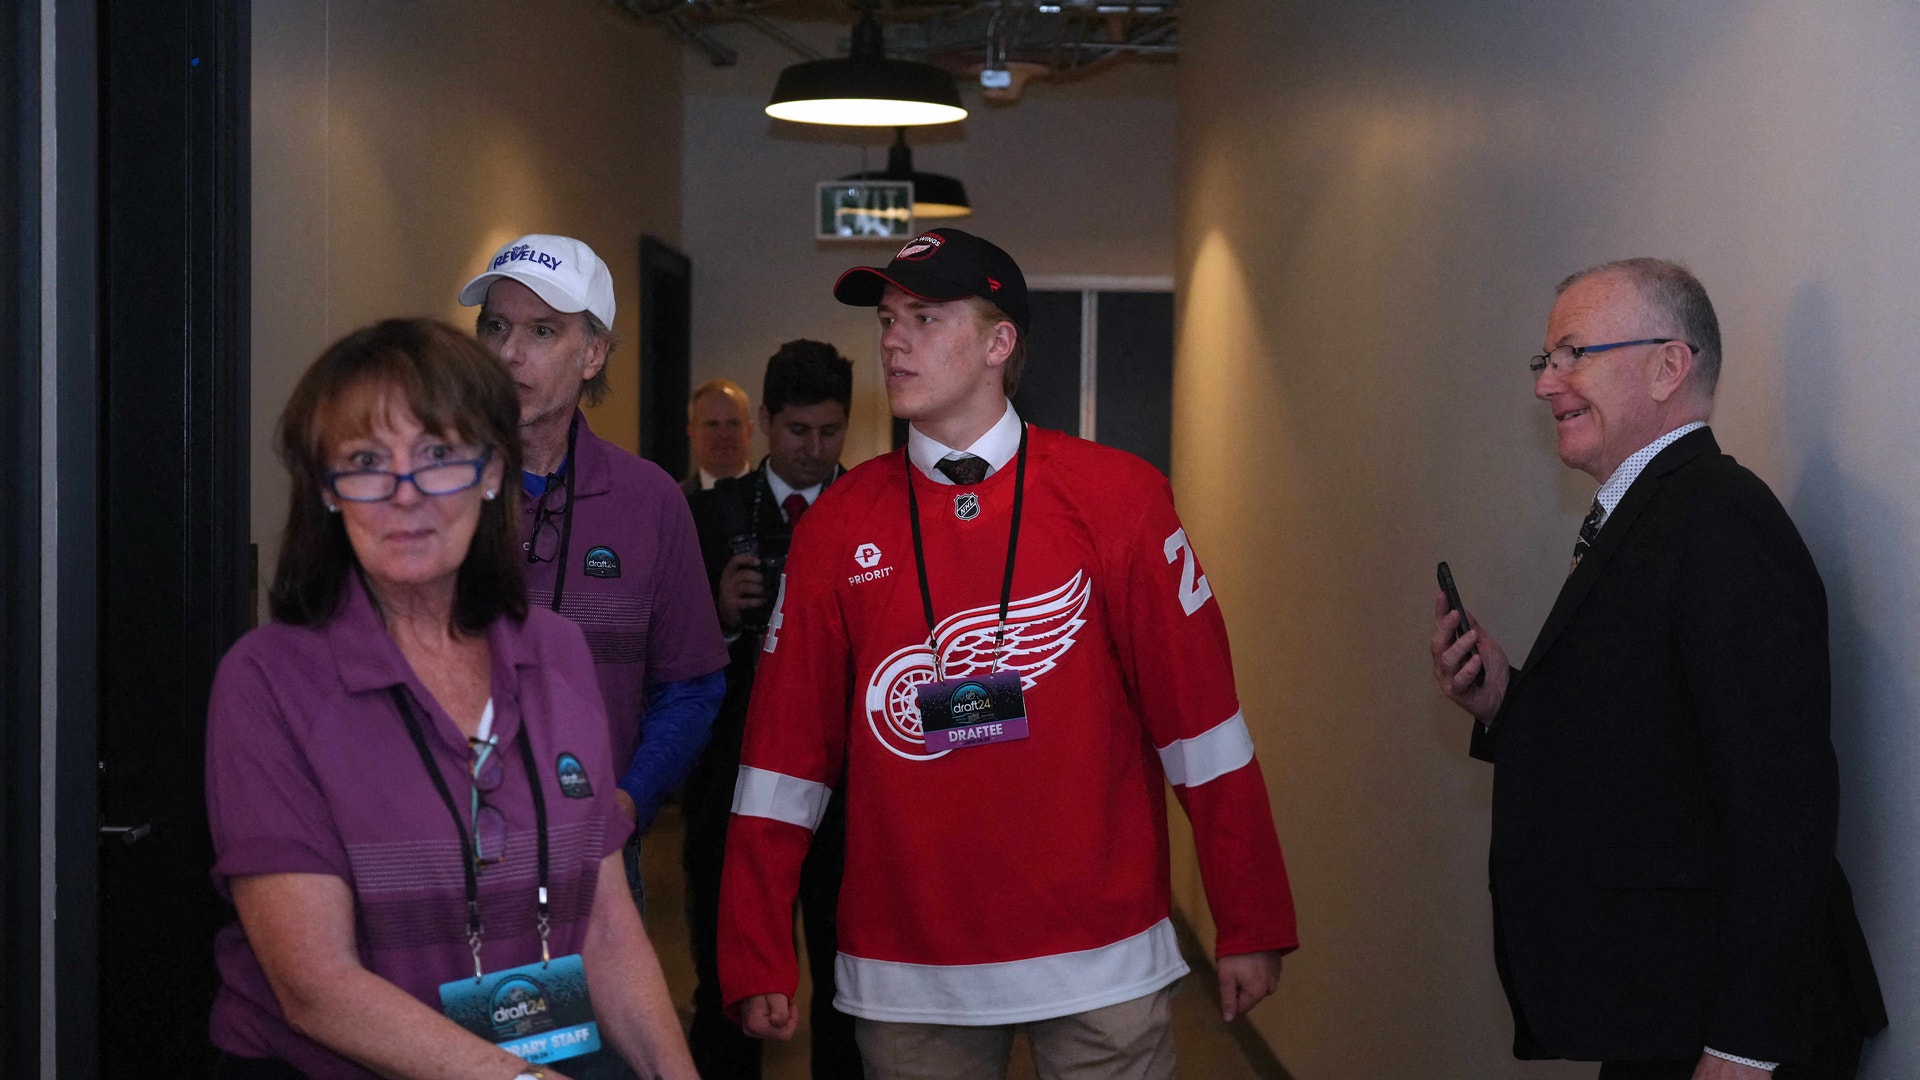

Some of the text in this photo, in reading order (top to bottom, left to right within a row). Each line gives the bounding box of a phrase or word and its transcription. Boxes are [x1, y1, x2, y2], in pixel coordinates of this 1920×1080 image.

[919, 236, 941, 247] WINGS
[493, 250, 562, 271] REVELRY
[960, 499, 974, 515] NHL
[953, 698, 992, 714] draft24
[948, 723, 1003, 743] DRAFTEE
[493, 998, 546, 1023] draft24
[550, 1027, 590, 1049] STAFF
